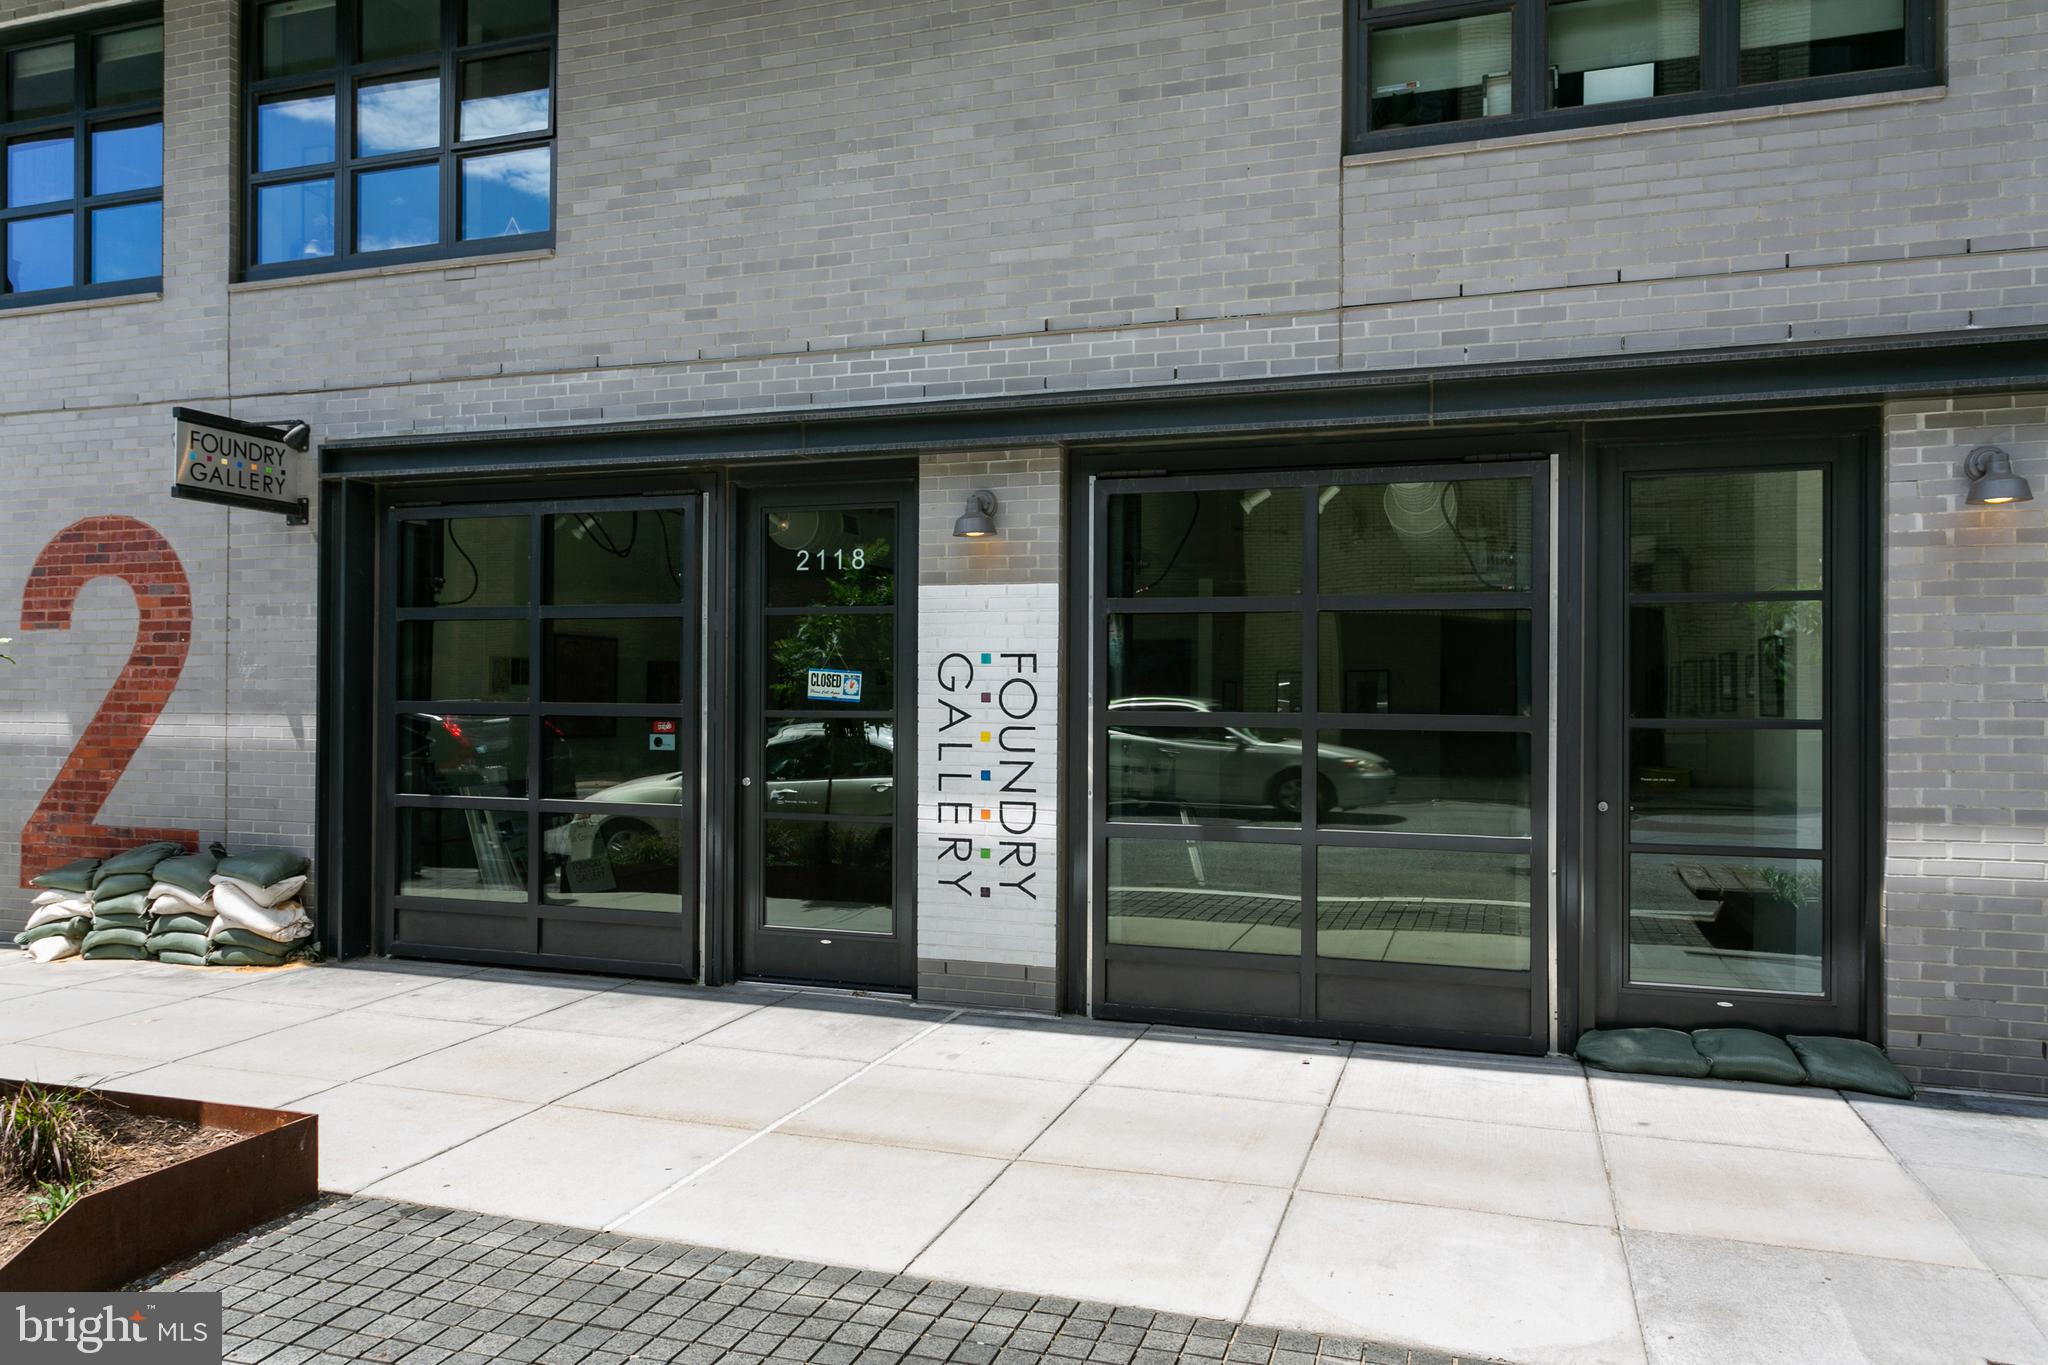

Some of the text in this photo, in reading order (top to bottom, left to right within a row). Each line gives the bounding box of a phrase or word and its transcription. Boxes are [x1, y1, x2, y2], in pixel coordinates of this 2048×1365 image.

[190, 430, 286, 467] FOUNDRY
[190, 461, 286, 494] GALLERY
[796, 548, 865, 571] 2118
[811, 673, 841, 687] CLOSED
[19, 514, 199, 890] 2
[937, 652, 974, 896] GALLERY
[998, 653, 1038, 900] FOUNDRY
